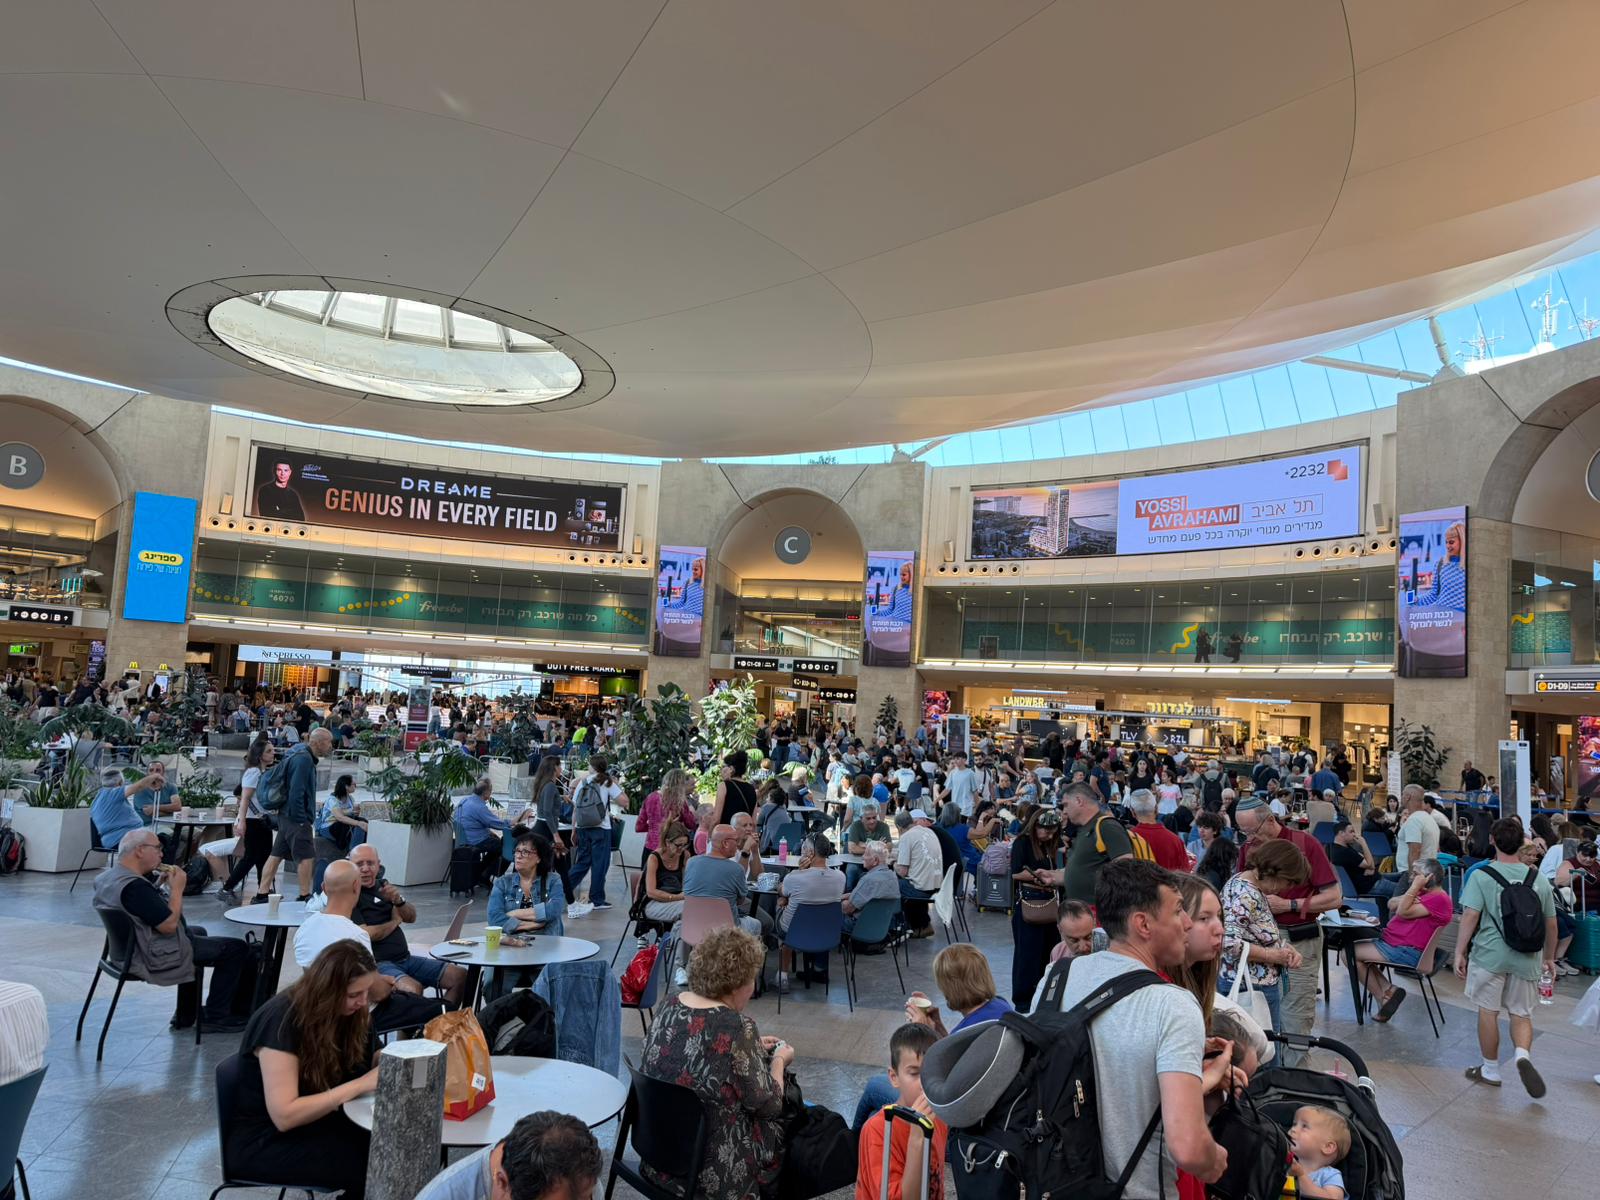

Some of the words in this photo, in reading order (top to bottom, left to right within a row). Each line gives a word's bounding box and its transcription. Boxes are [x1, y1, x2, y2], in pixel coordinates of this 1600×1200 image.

[9, 455, 27, 476] B
[401, 477, 492, 499] DREAME
[325, 487, 404, 517] GENIUS
[409, 497, 431, 520] IN
[437, 500, 500, 527] EVERY
[505, 507, 557, 532] FIELD
[1138, 497, 1185, 514] YOSSI
[1251, 503, 1286, 518] אביב
[1293, 499, 1313, 514] תל
[1152, 507, 1237, 529] AVRAHAMI
[1256, 525, 1280, 535] מגורי
[1284, 520, 1323, 533] מגדירים
[1148, 535, 1177, 544] מחדש
[1180, 532, 1201, 542] פעם
[1204, 529, 1223, 540] בכל
[1227, 528, 1253, 539] יוקרה
[784, 536, 798, 554] C
[262, 650, 311, 660] NESPRESSO
[1547, 682, 1569, 690] D1-D9
[1120, 731, 1138, 740] TLV
[1170, 734, 1187, 744] RZL
